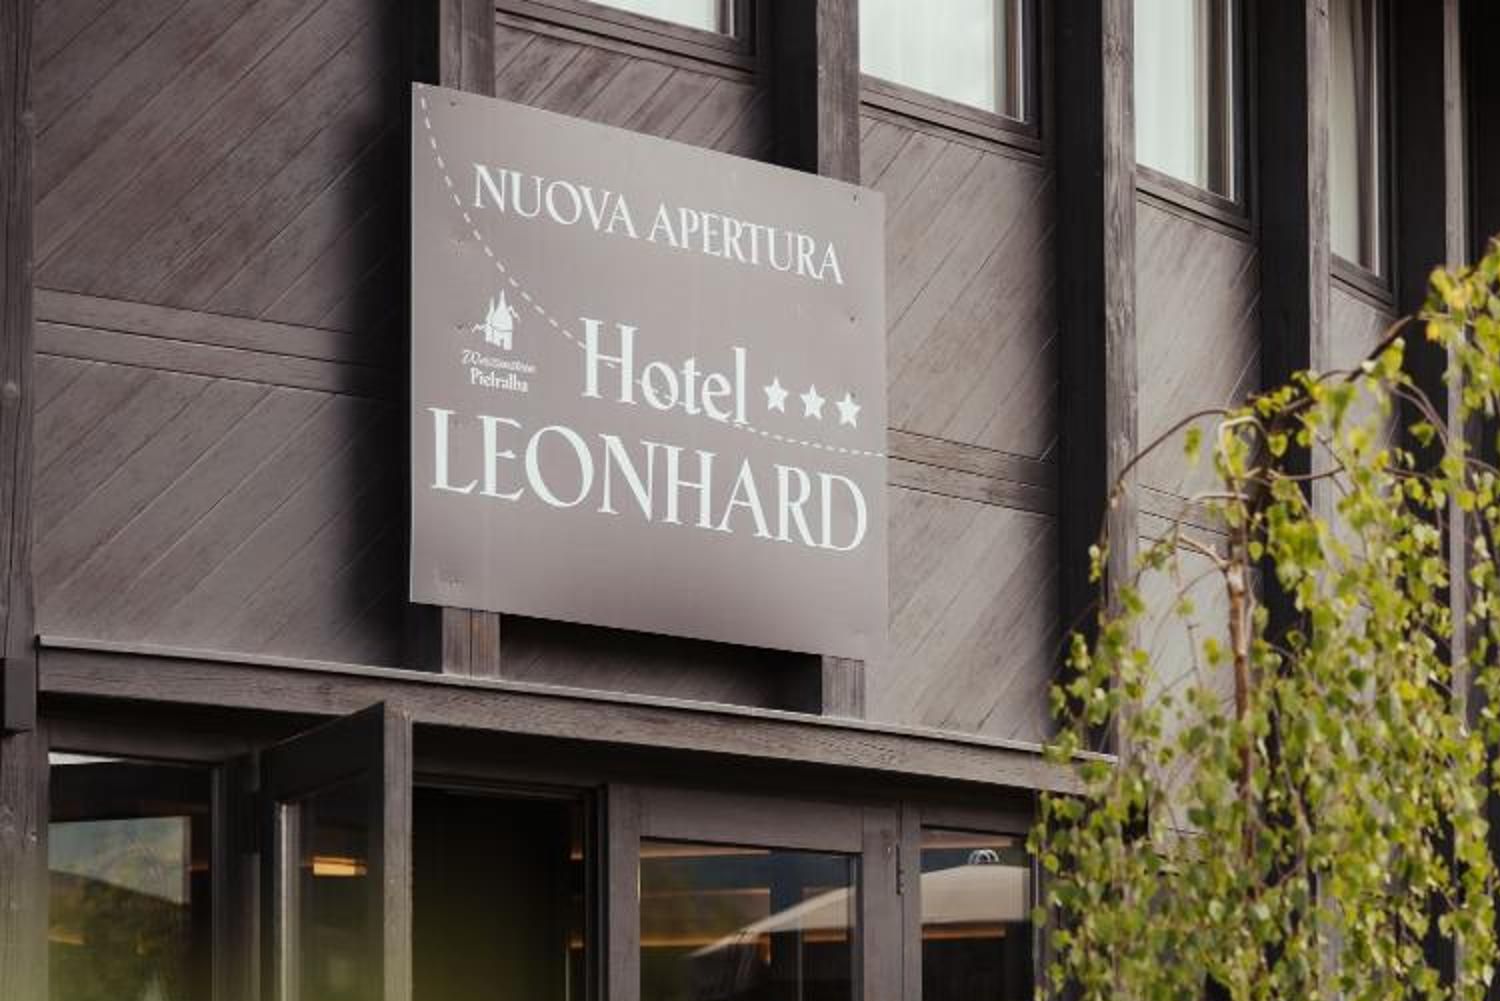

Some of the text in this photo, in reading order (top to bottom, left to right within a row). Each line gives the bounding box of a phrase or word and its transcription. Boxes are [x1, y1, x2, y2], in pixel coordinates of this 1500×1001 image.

[473, 164, 844, 284] NUOVA APERTURA
[579, 317, 750, 425] Hotel
[428, 407, 868, 551] LEONHARD
